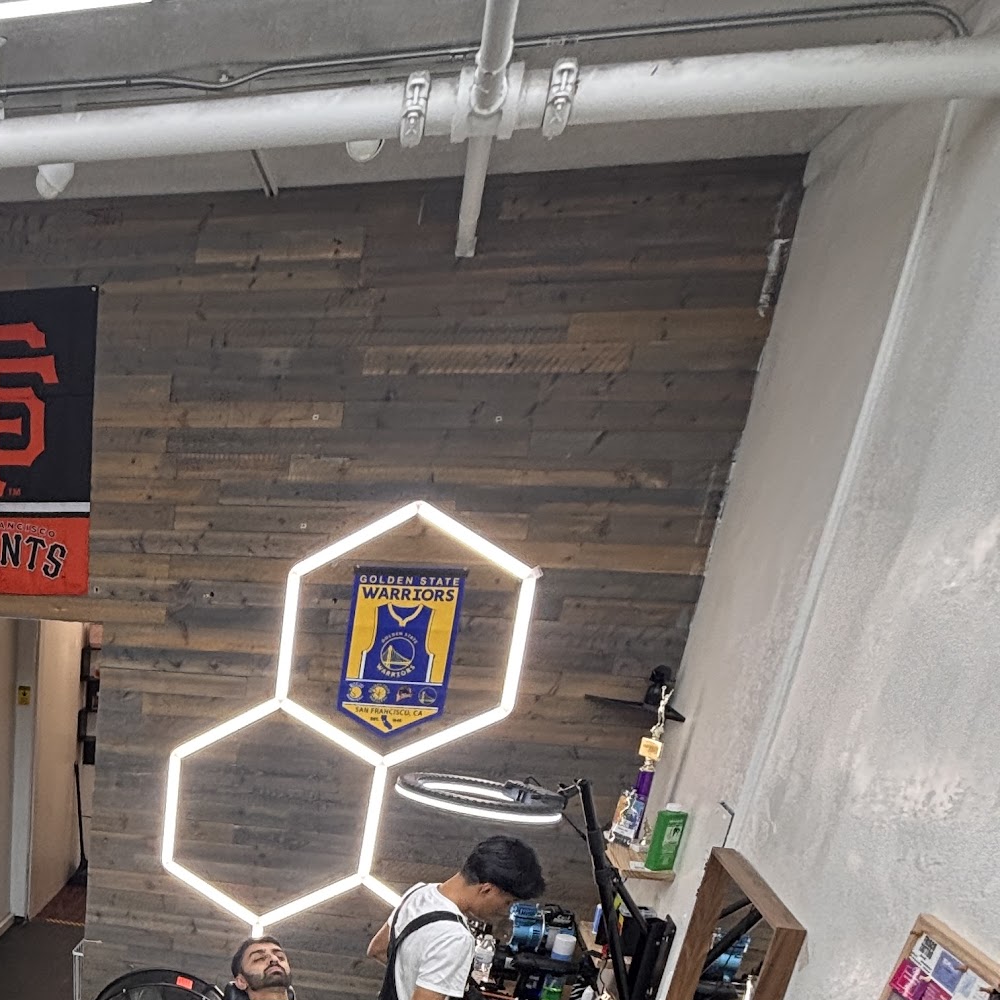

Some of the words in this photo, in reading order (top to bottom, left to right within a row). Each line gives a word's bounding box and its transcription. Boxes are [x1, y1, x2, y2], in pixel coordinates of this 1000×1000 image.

[360, 574, 414, 585] GOLDEN
[420, 576, 460, 586] STATE
[362, 586, 455, 602] WARRIORS
[377, 663, 415, 678] WARRIORS
